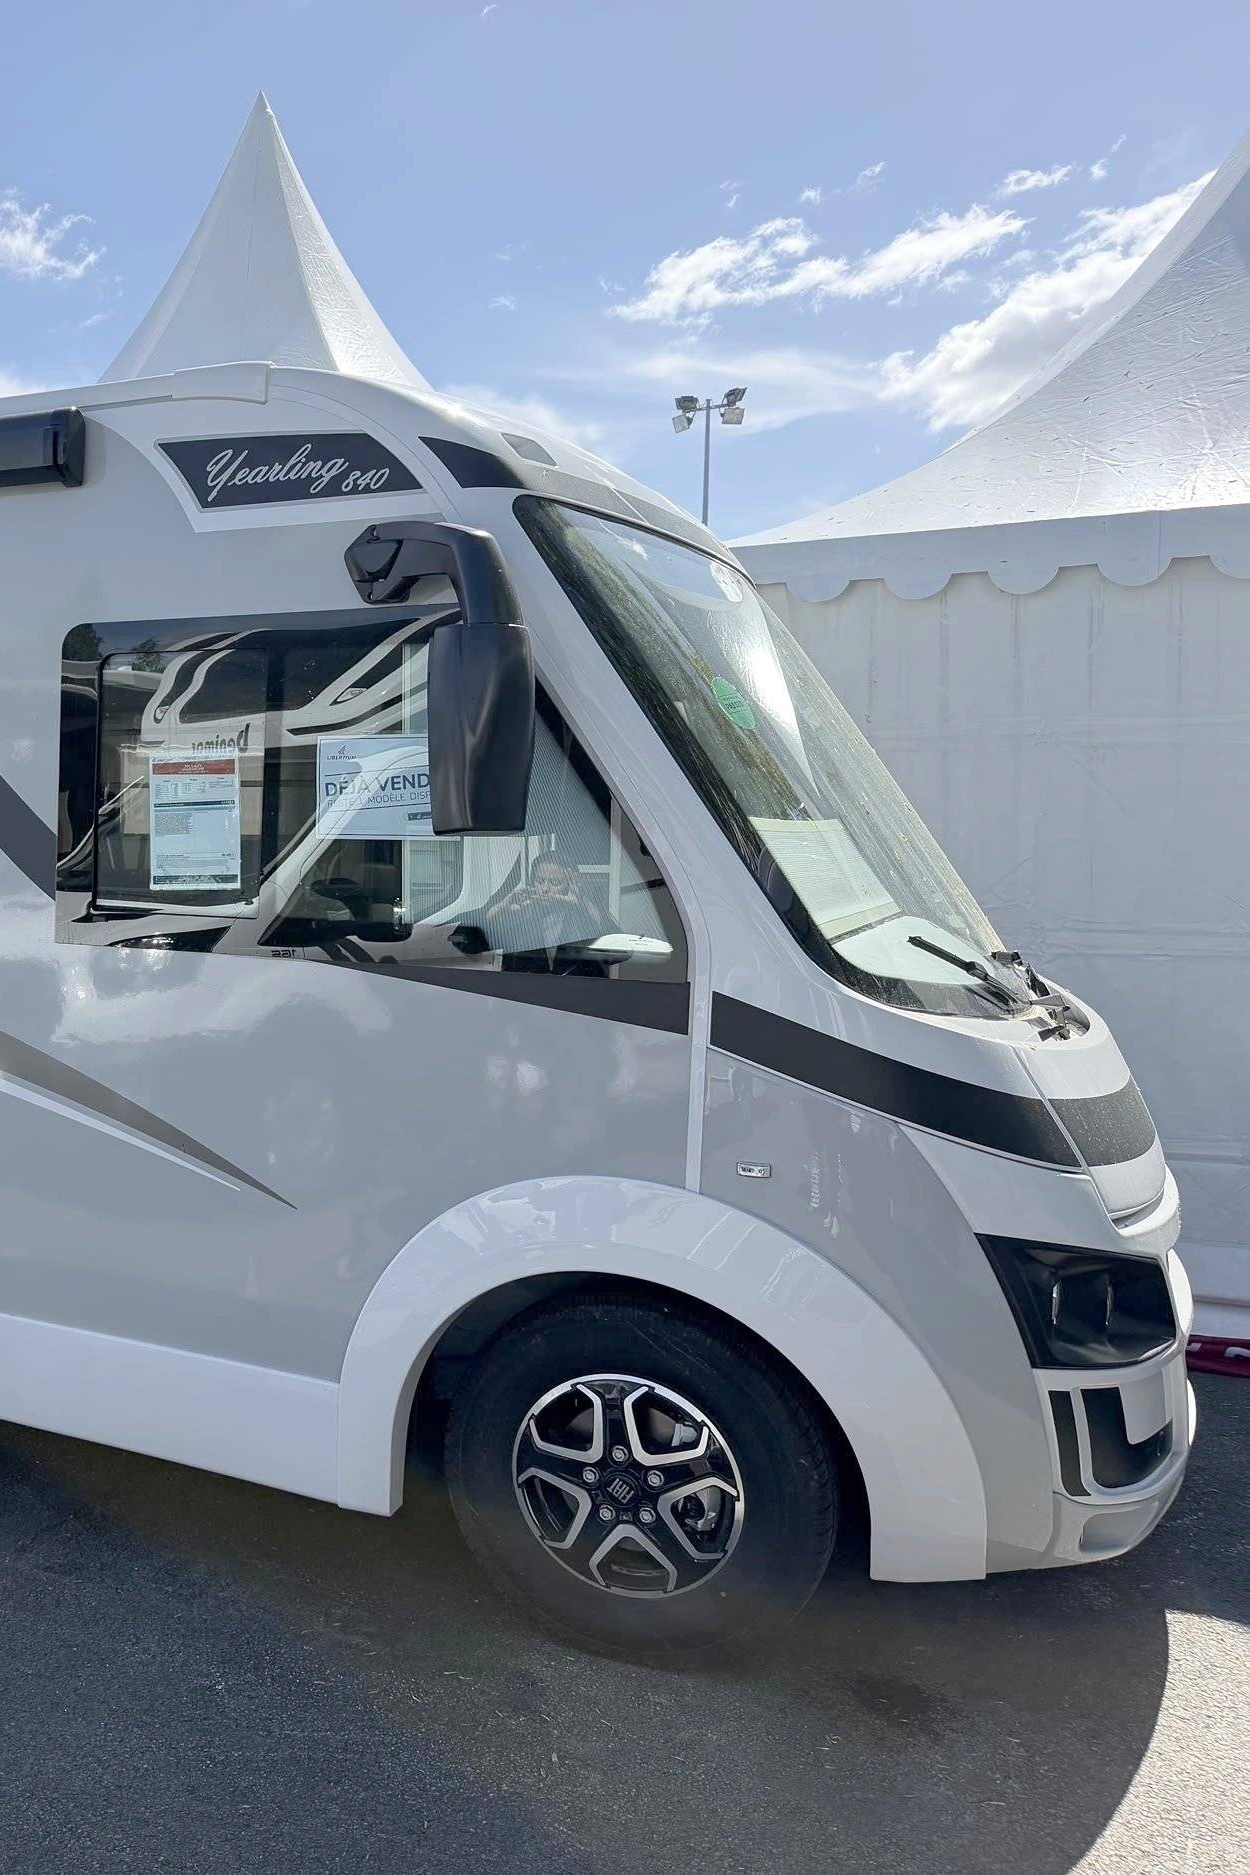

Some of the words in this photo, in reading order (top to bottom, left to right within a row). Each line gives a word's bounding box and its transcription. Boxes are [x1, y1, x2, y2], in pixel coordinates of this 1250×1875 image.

[206, 443, 350, 502] Yearling
[341, 468, 390, 492] 840
[367, 793, 406, 804] MODÈLE
[606, 1478, 635, 1504] FIAT
